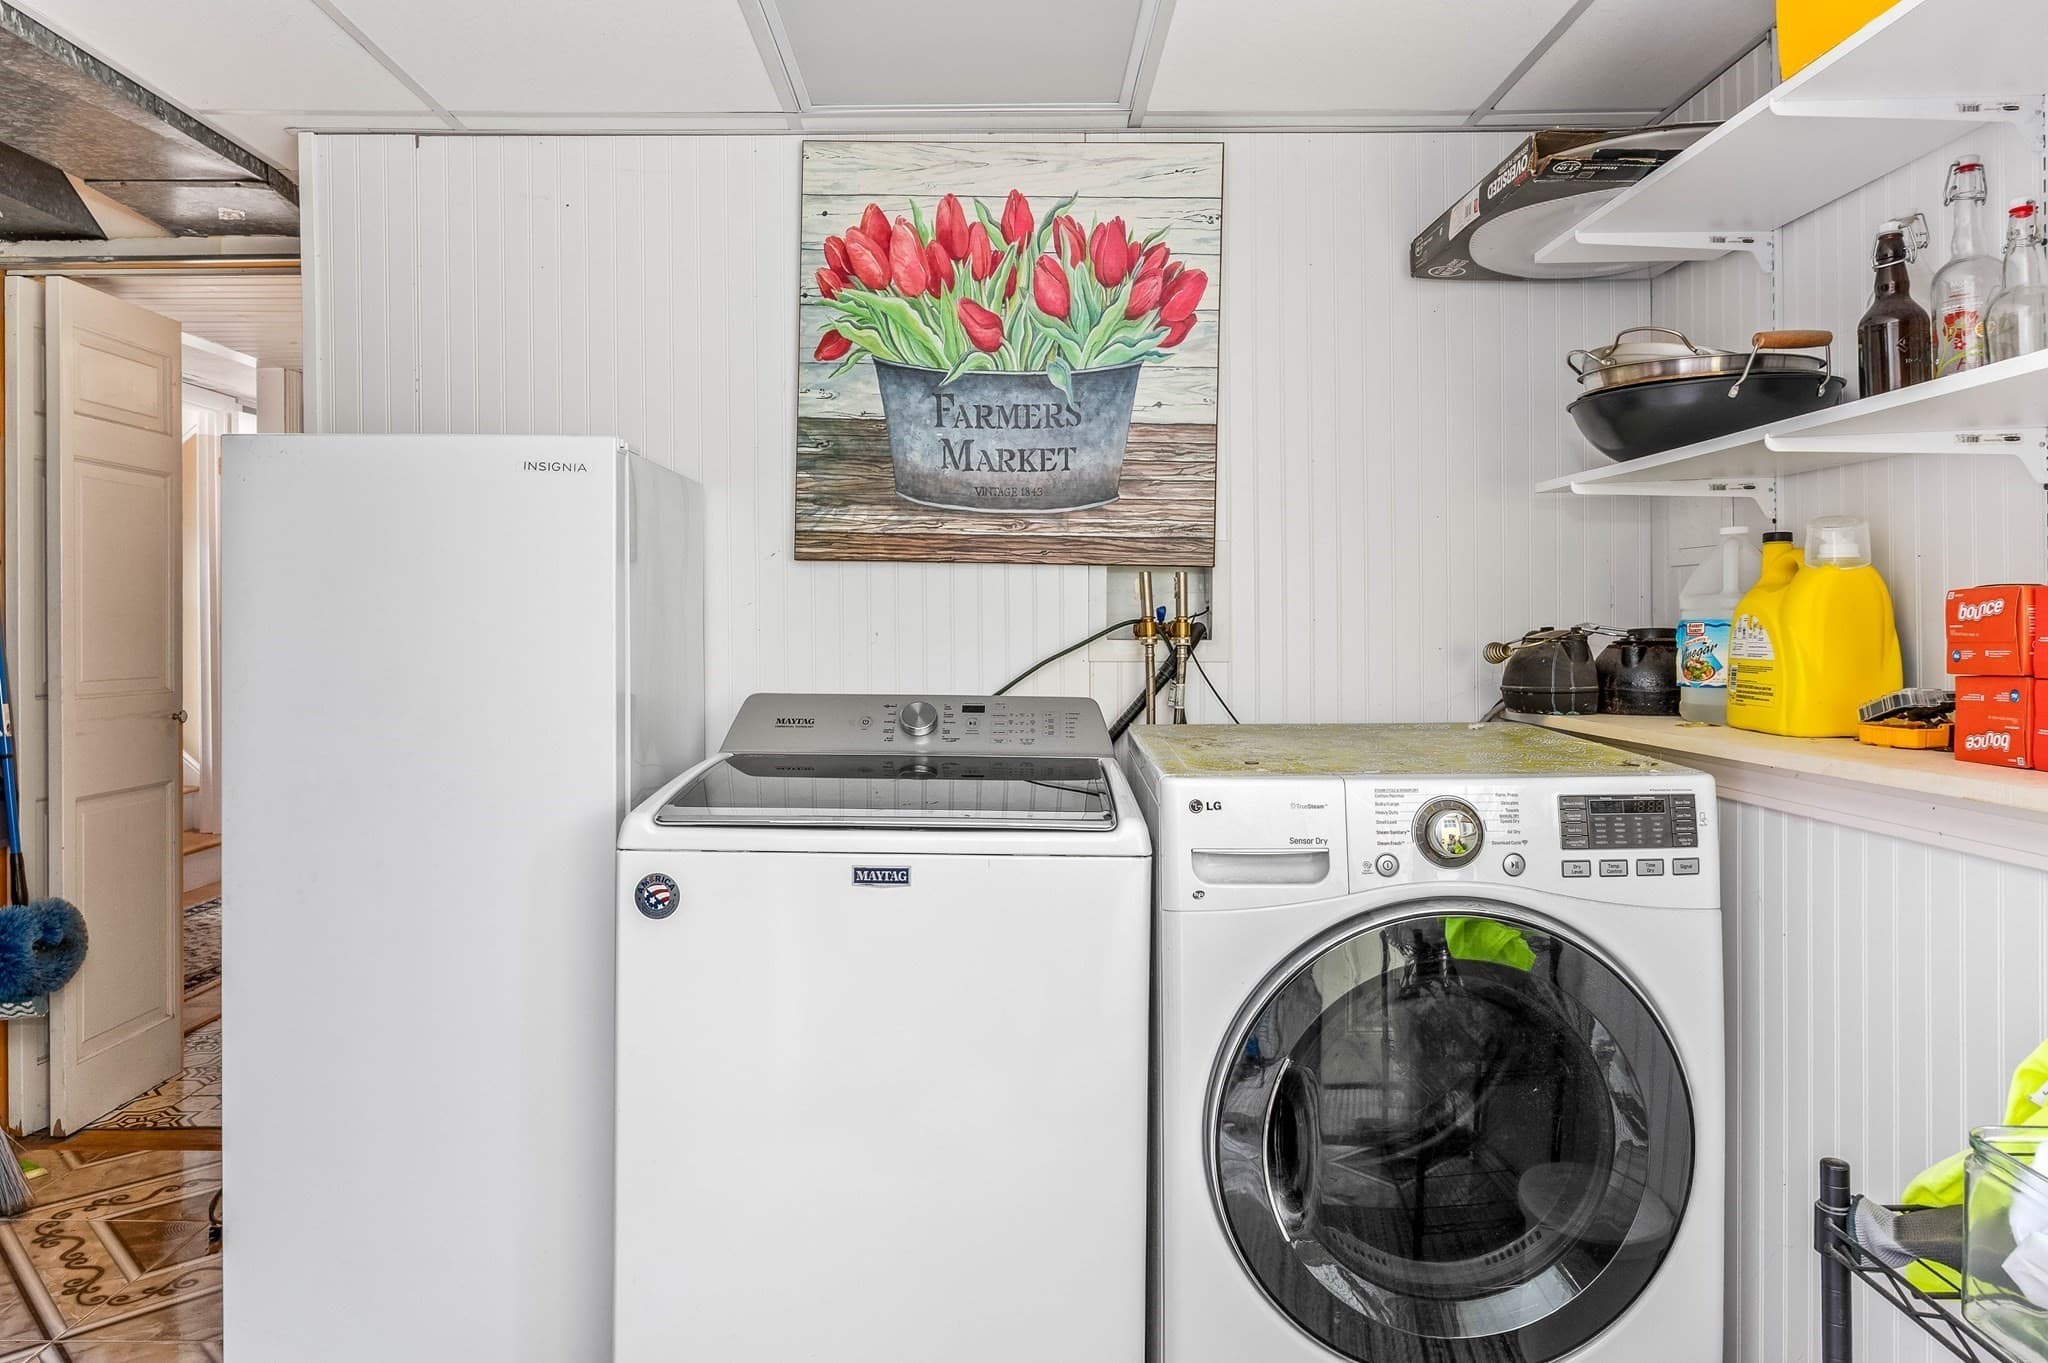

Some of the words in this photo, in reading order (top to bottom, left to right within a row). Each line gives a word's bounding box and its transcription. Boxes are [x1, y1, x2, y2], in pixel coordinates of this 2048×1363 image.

[1487, 154, 1528, 200] OVERSIZED
[932, 392, 1082, 430] FARMERS
[938, 437, 1077, 473] MARKET
[523, 461, 588, 472] INSIGNIA
[973, 486, 1018, 497] VINTAGE
[1021, 486, 1043, 497] 1843
[1958, 598, 2004, 622] bounce
[1965, 731, 2011, 752] bounce
[1206, 801, 1222, 811] LG
[1289, 837, 1314, 845] Sensor
[1315, 837, 1329, 847] Dry
[855, 870, 908, 882] MAYTAG
